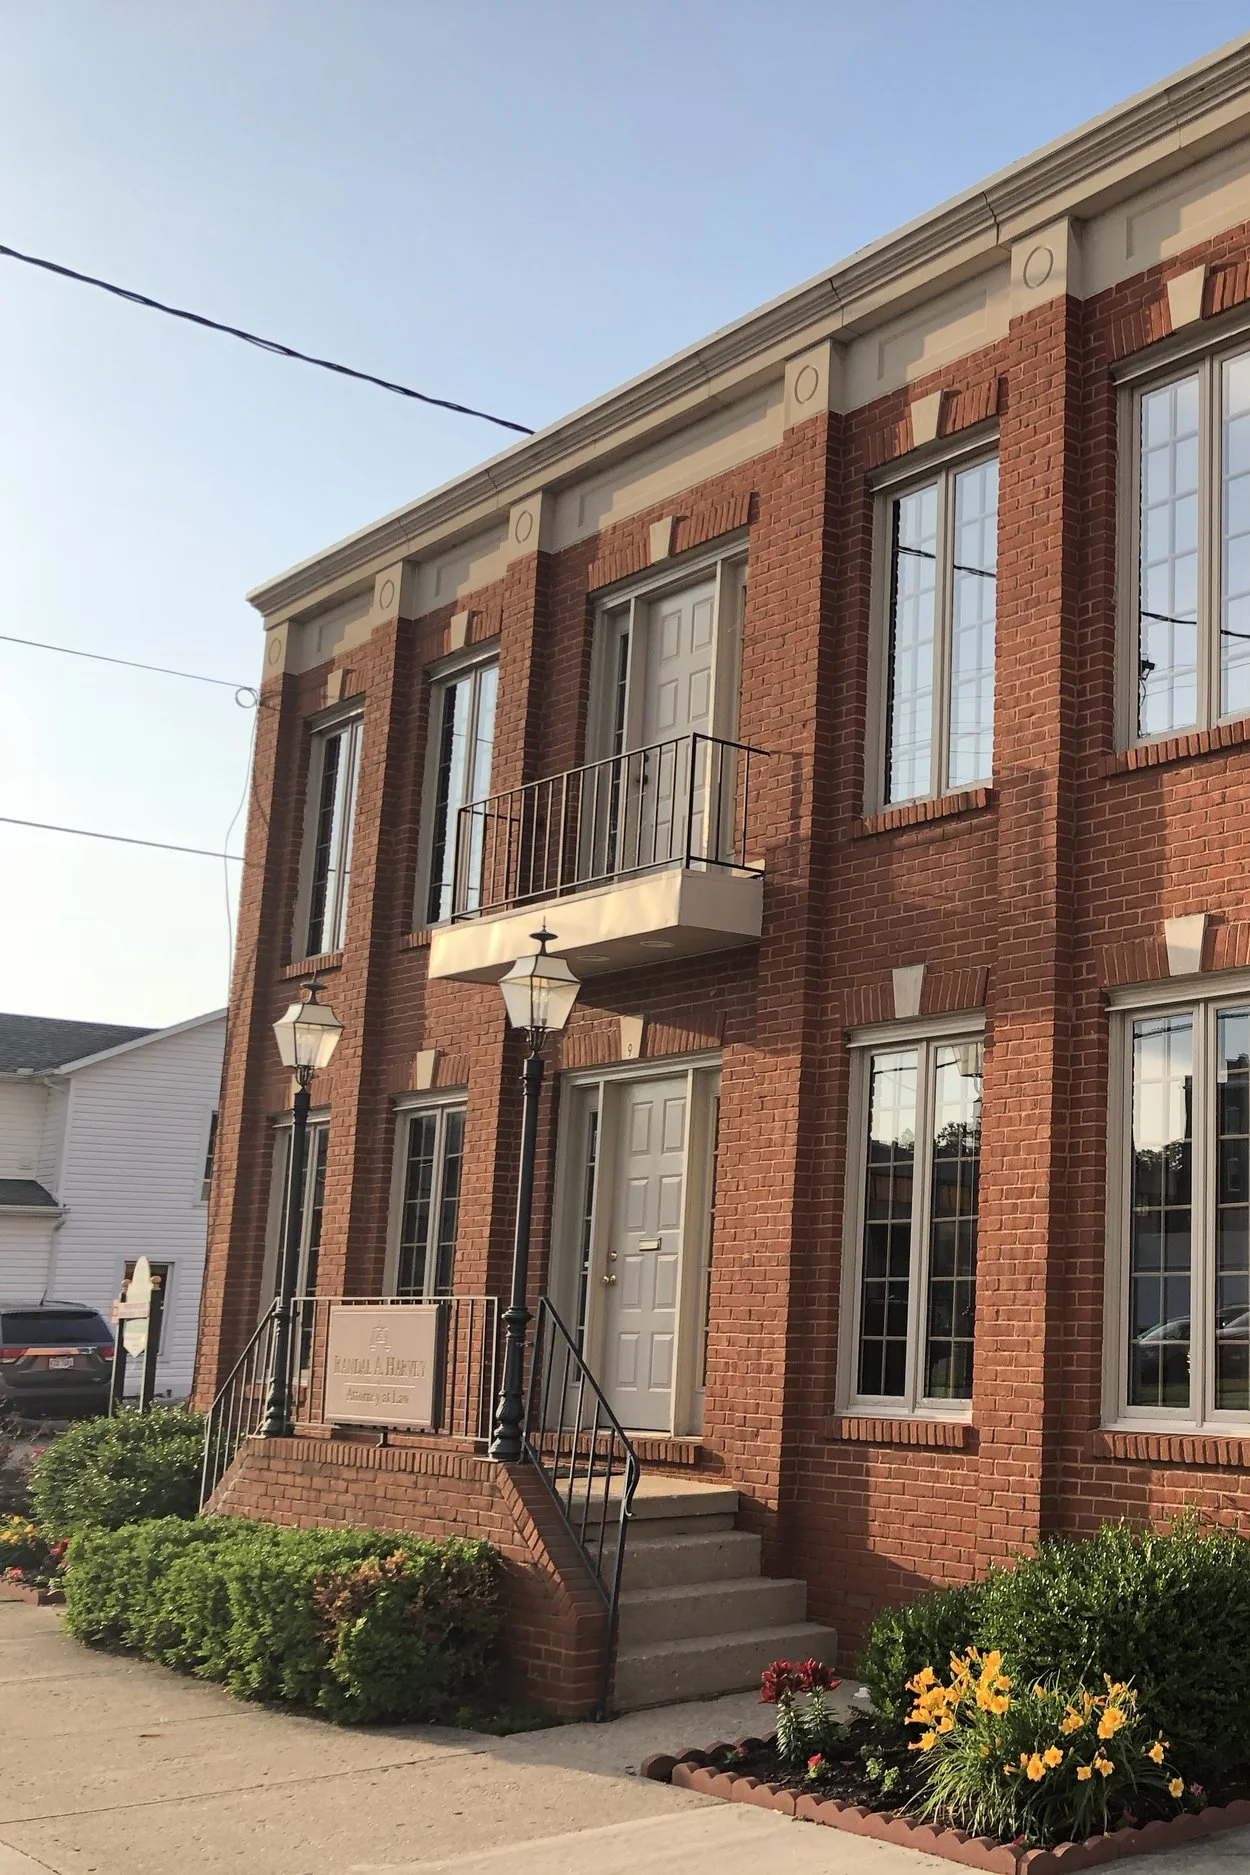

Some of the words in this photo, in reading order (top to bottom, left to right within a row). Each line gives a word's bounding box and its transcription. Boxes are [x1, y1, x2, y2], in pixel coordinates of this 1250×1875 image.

[627, 1043, 633, 1057] 9
[333, 1355, 372, 1376] RANDAL
[385, 1357, 426, 1378] HARVEY
[346, 1388, 380, 1407] Attorney
[391, 1390, 410, 1405] Law
